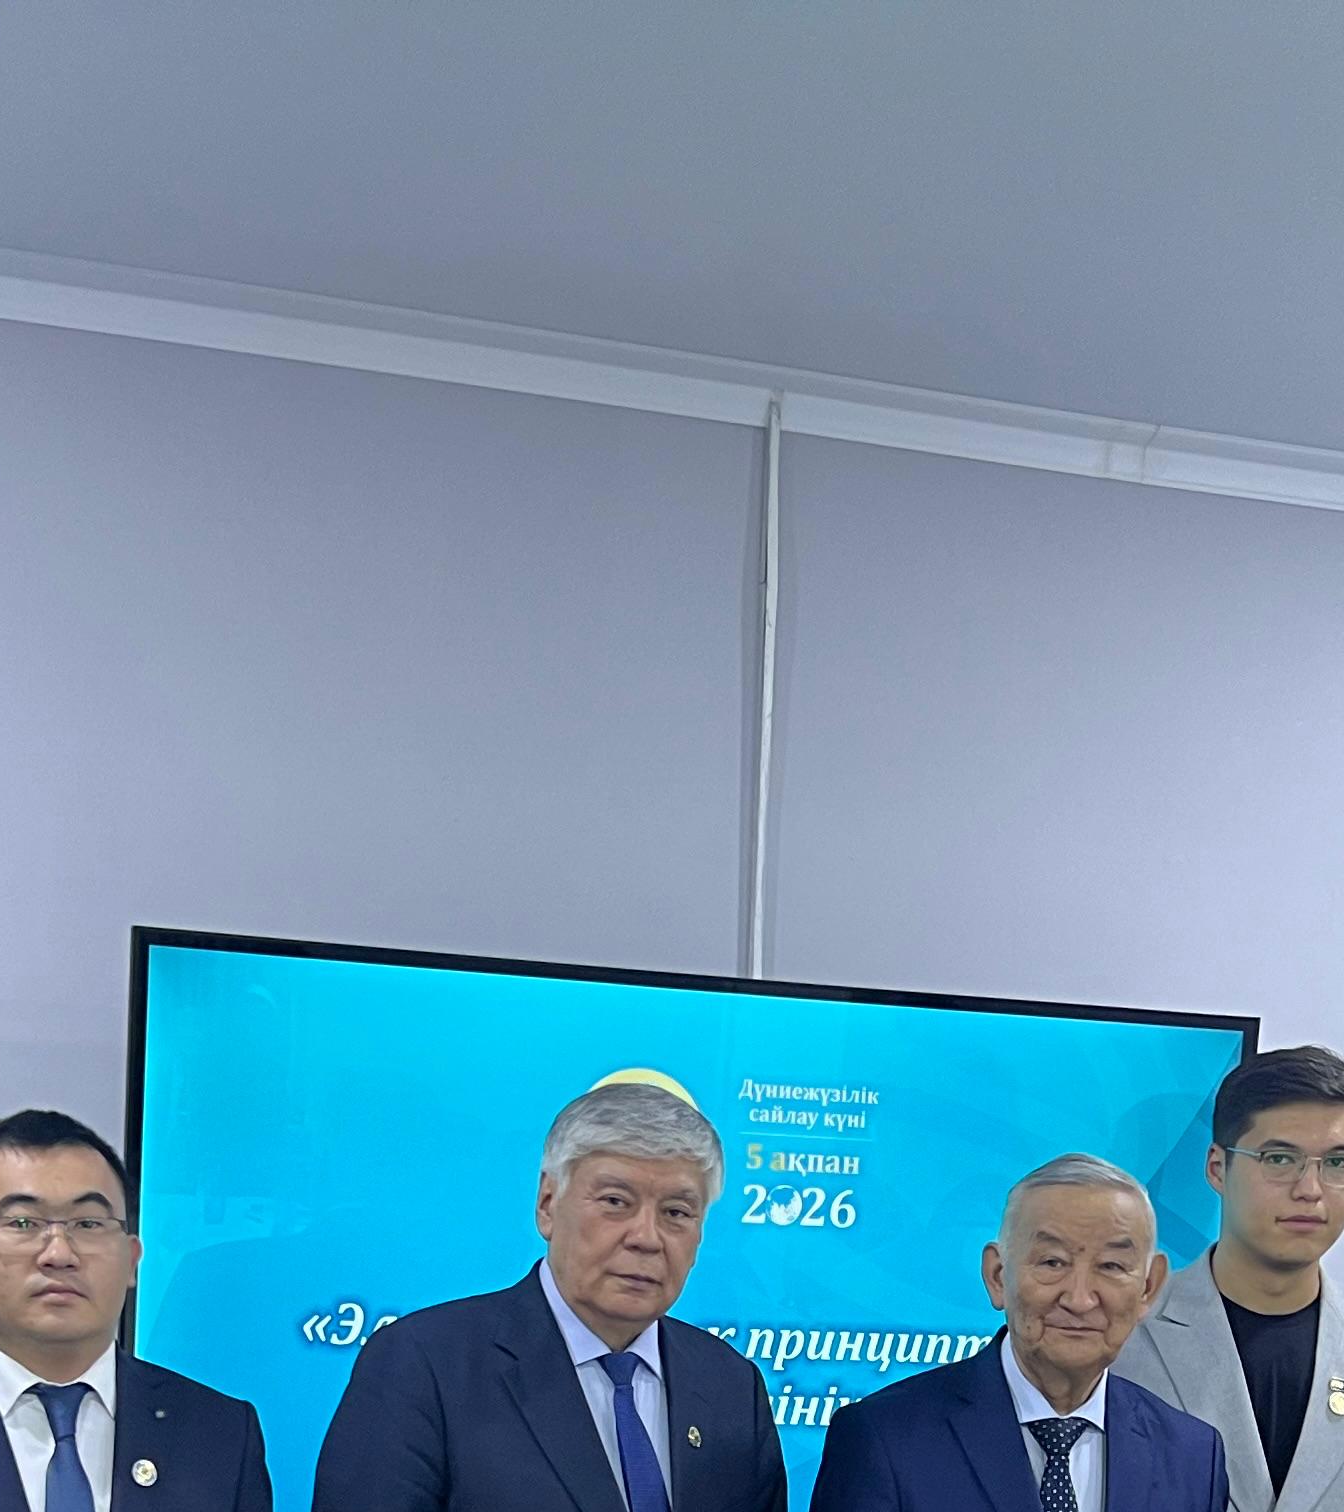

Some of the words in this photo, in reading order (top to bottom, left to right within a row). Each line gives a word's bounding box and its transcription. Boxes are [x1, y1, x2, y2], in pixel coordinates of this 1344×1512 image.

[738, 1079, 879, 1107] Дүниежүзілік
[749, 1105, 819, 1130] сайлау
[824, 1111, 866, 1132] күні
[746, 1143, 763, 1169] 5
[770, 1151, 860, 1177] ақпан
